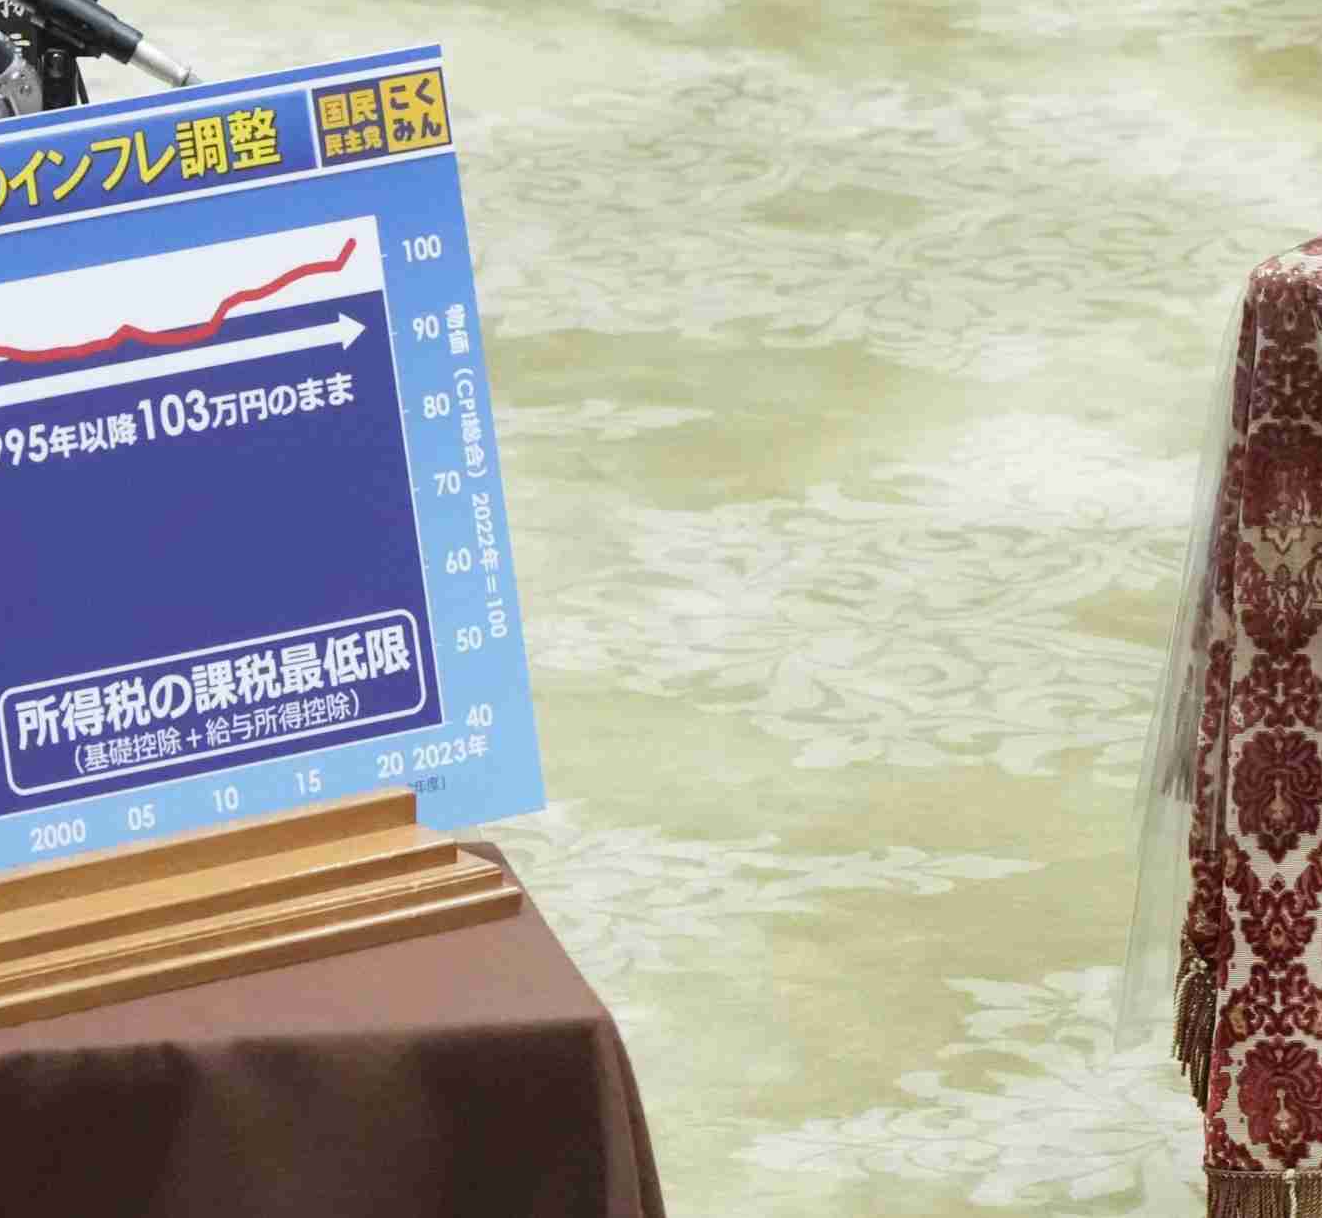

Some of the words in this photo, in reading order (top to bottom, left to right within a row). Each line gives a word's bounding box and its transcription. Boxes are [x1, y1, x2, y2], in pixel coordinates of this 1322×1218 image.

[390, 78, 435, 110] こく
[319, 89, 378, 129] 国民
[393, 112, 442, 141] みん
[325, 126, 383, 157] 民主党
[402, 235, 442, 262] 100
[412, 315, 440, 342] 90
[423, 393, 450, 419] 80
[434, 470, 462, 497] 70
[445, 548, 472, 575] 60
[456, 626, 483, 653] 50
[16, 624, 412, 751] 所得税の課税最低限
[465, 703, 493, 728] 40
[376, 751, 404, 779] 20
[412, 736, 489, 771] 2023年
[296, 769, 322, 797] 15
[213, 786, 240, 814] 10
[128, 804, 156, 832] 05
[30, 818, 86, 853] 2000
